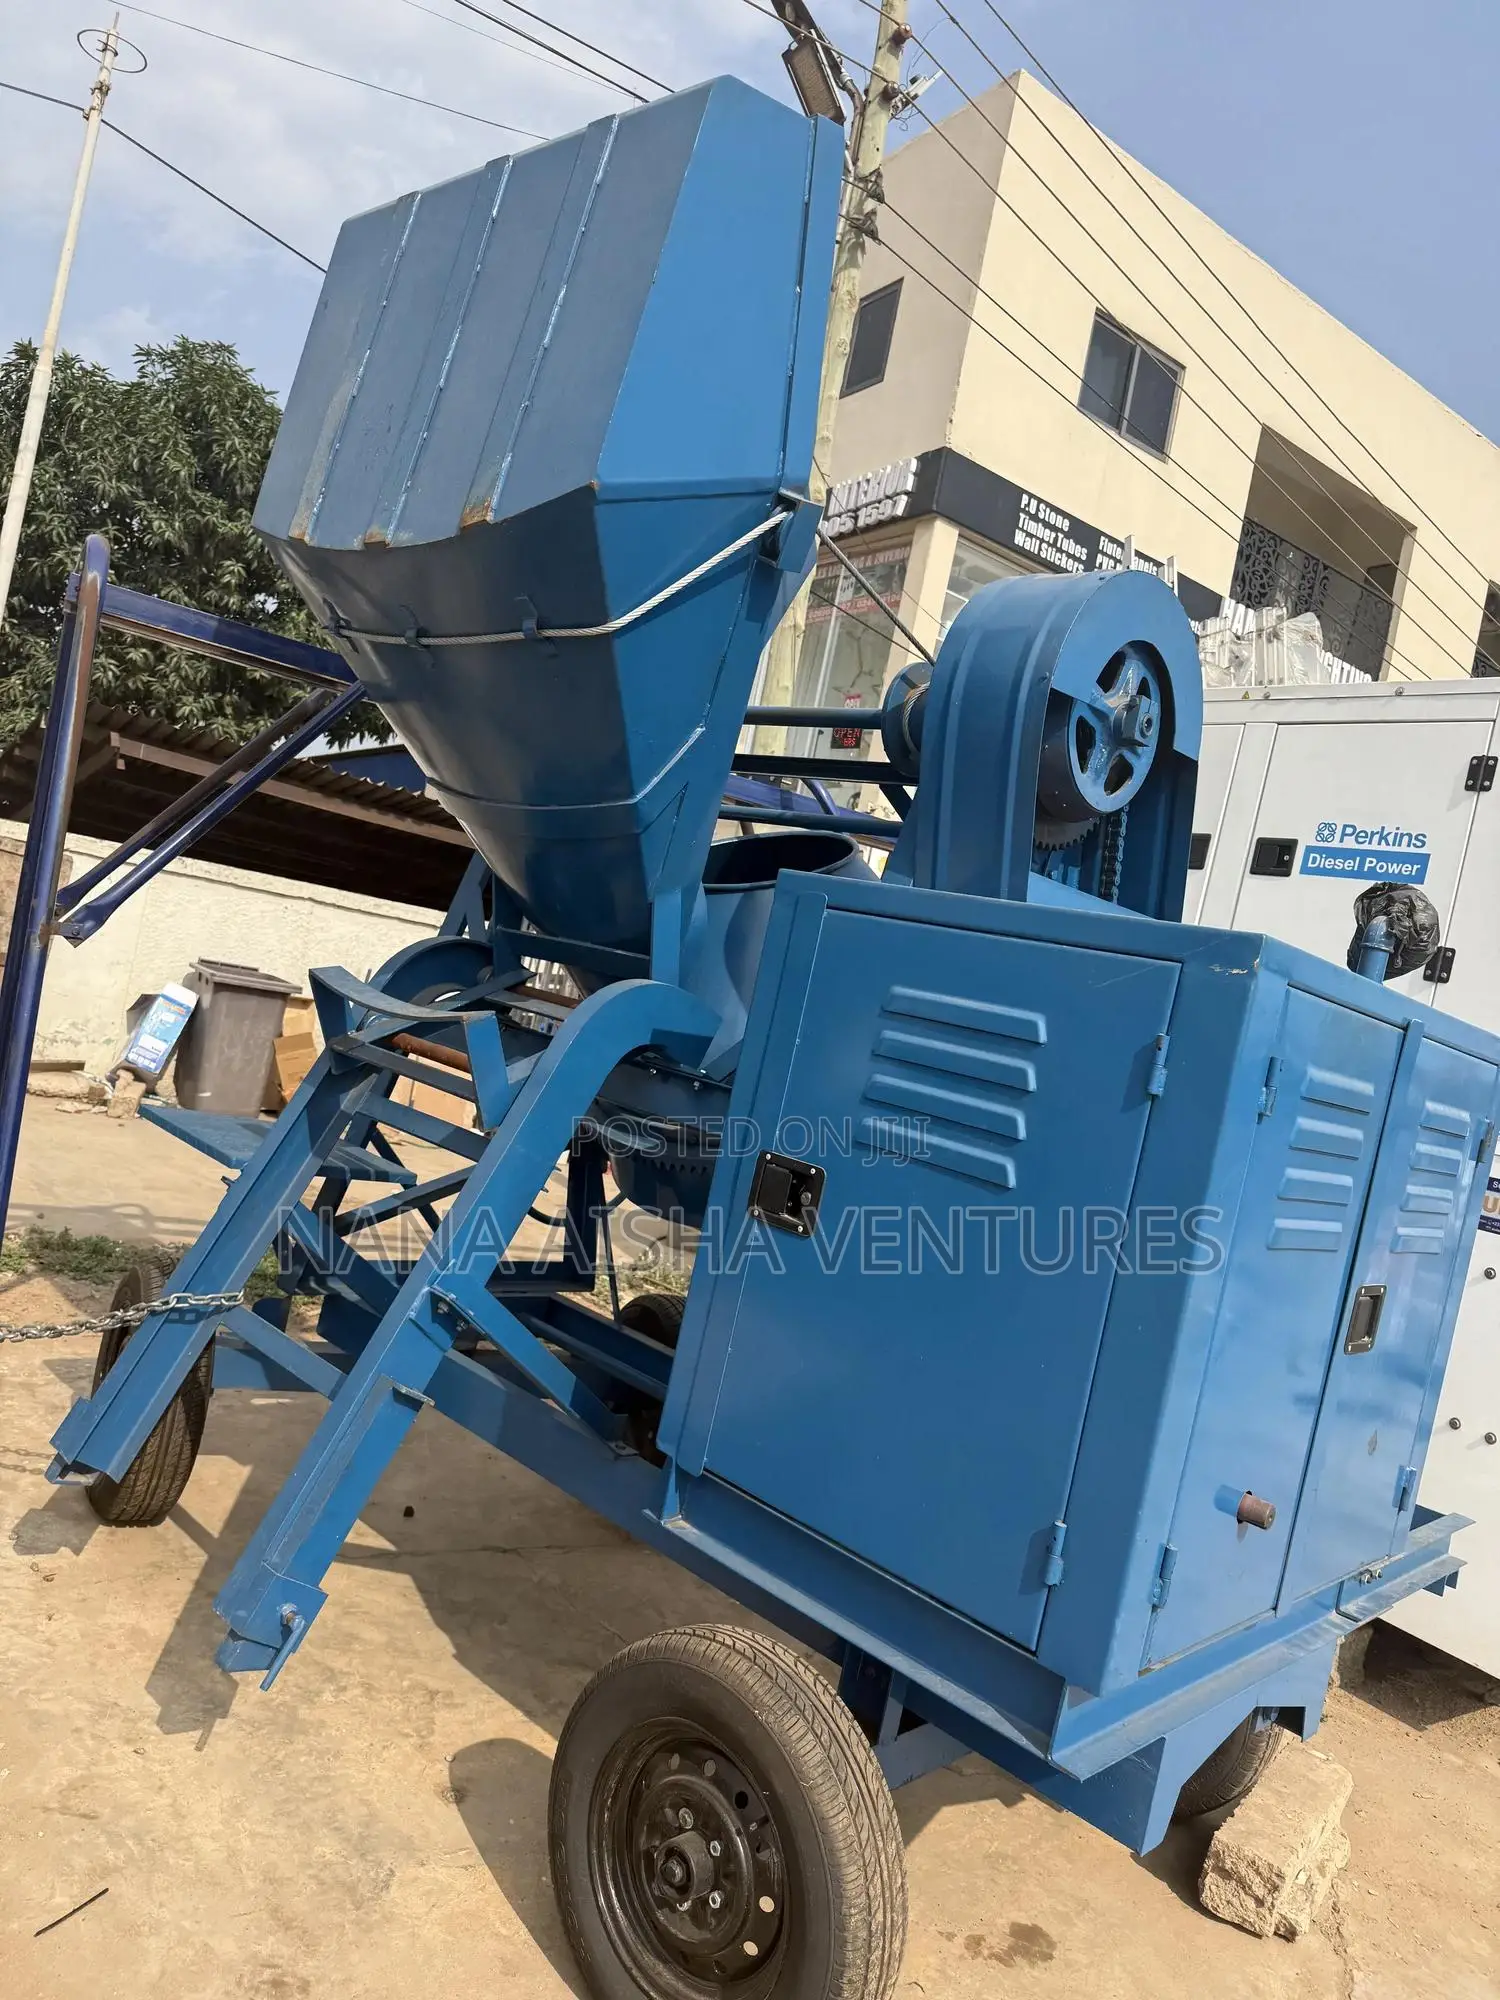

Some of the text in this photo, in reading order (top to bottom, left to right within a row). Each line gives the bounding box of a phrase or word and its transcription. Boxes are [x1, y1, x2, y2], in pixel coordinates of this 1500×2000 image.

[857, 494, 908, 528] 1597
[1020, 493, 1070, 532] P.U Stone
[1014, 528, 1084, 574] Wall Stickers
[1018, 512, 1088, 561] Timber Tubes
[1099, 535, 1124, 561] Flute
[1339, 823, 1427, 849] Perkins
[1307, 853, 1421, 876] Diesel Power
